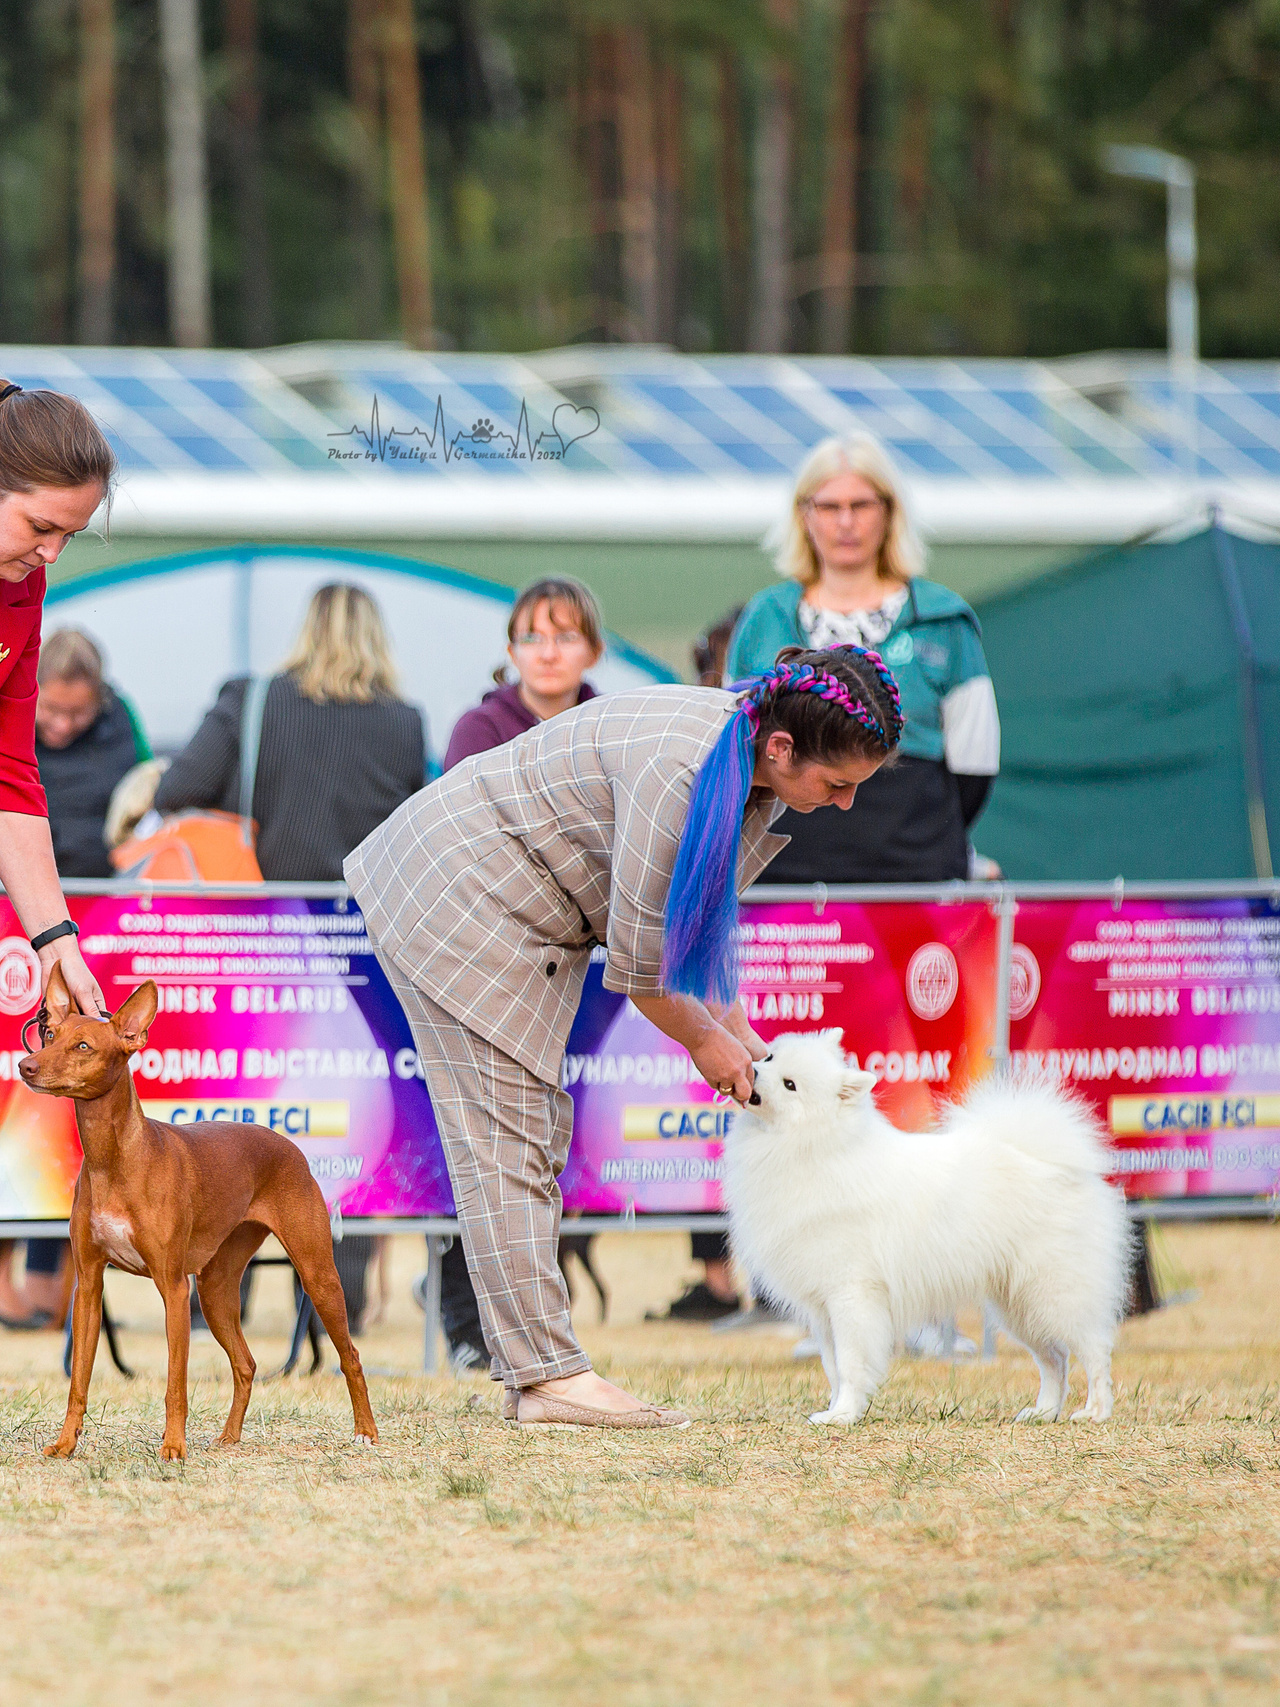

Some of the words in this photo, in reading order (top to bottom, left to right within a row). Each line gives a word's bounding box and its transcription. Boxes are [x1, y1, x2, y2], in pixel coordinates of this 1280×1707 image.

[231, 985, 349, 1014] BELARUS
[1108, 987, 1180, 1017] MINSK
[242, 1048, 390, 1080] ВЫСТАВКА
[865, 1050, 952, 1083] СОБАК
[269, 1107, 309, 1134] FCI
[1143, 1102, 1211, 1131] CACIB
